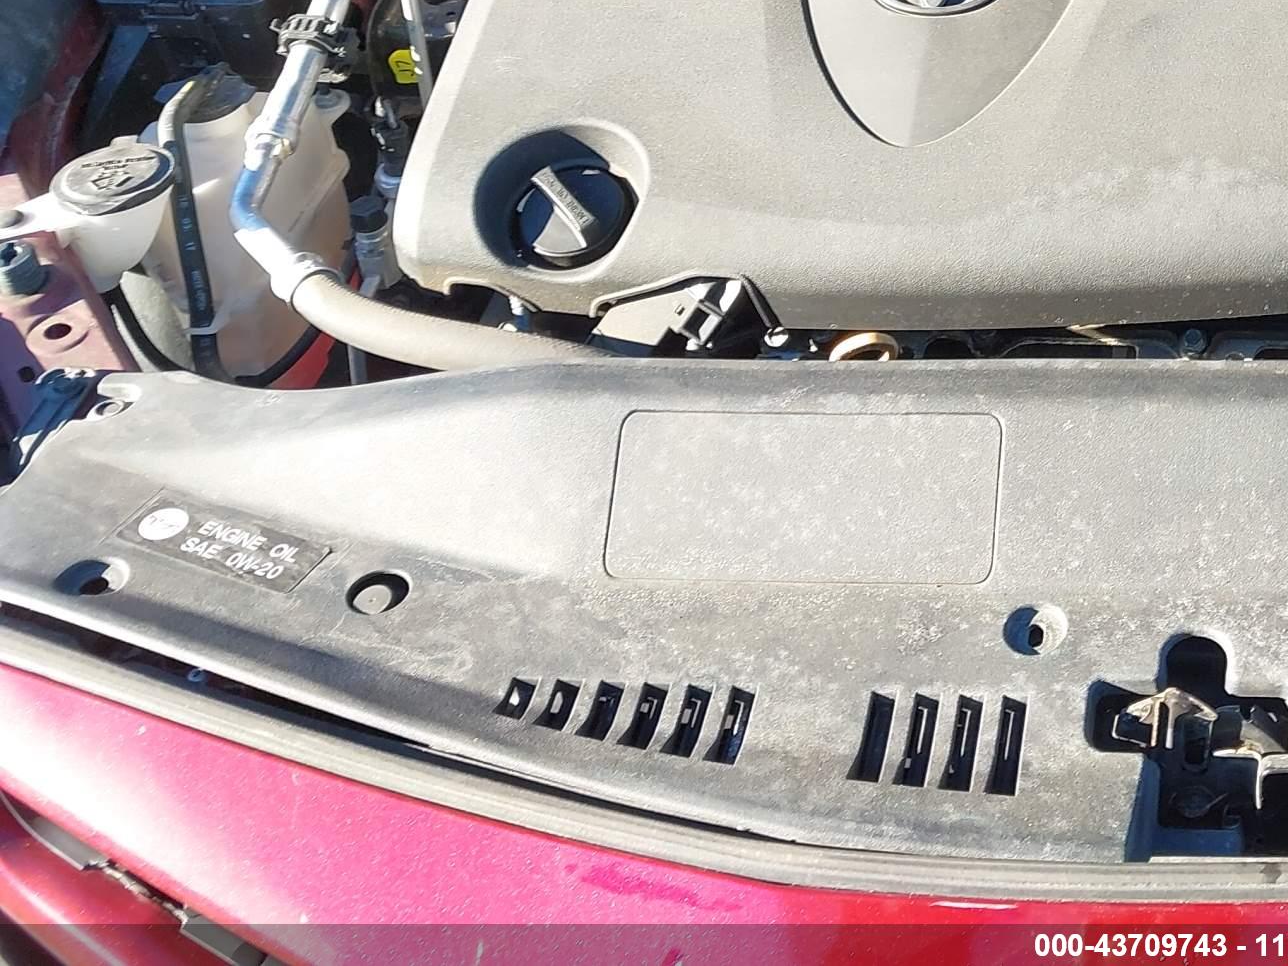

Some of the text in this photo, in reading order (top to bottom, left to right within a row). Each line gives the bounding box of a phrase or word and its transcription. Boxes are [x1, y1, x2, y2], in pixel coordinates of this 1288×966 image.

[180, 536, 284, 579] SAE 0W-20
[197, 520, 268, 551] ENGINE
[269, 543, 299, 563] OIL
